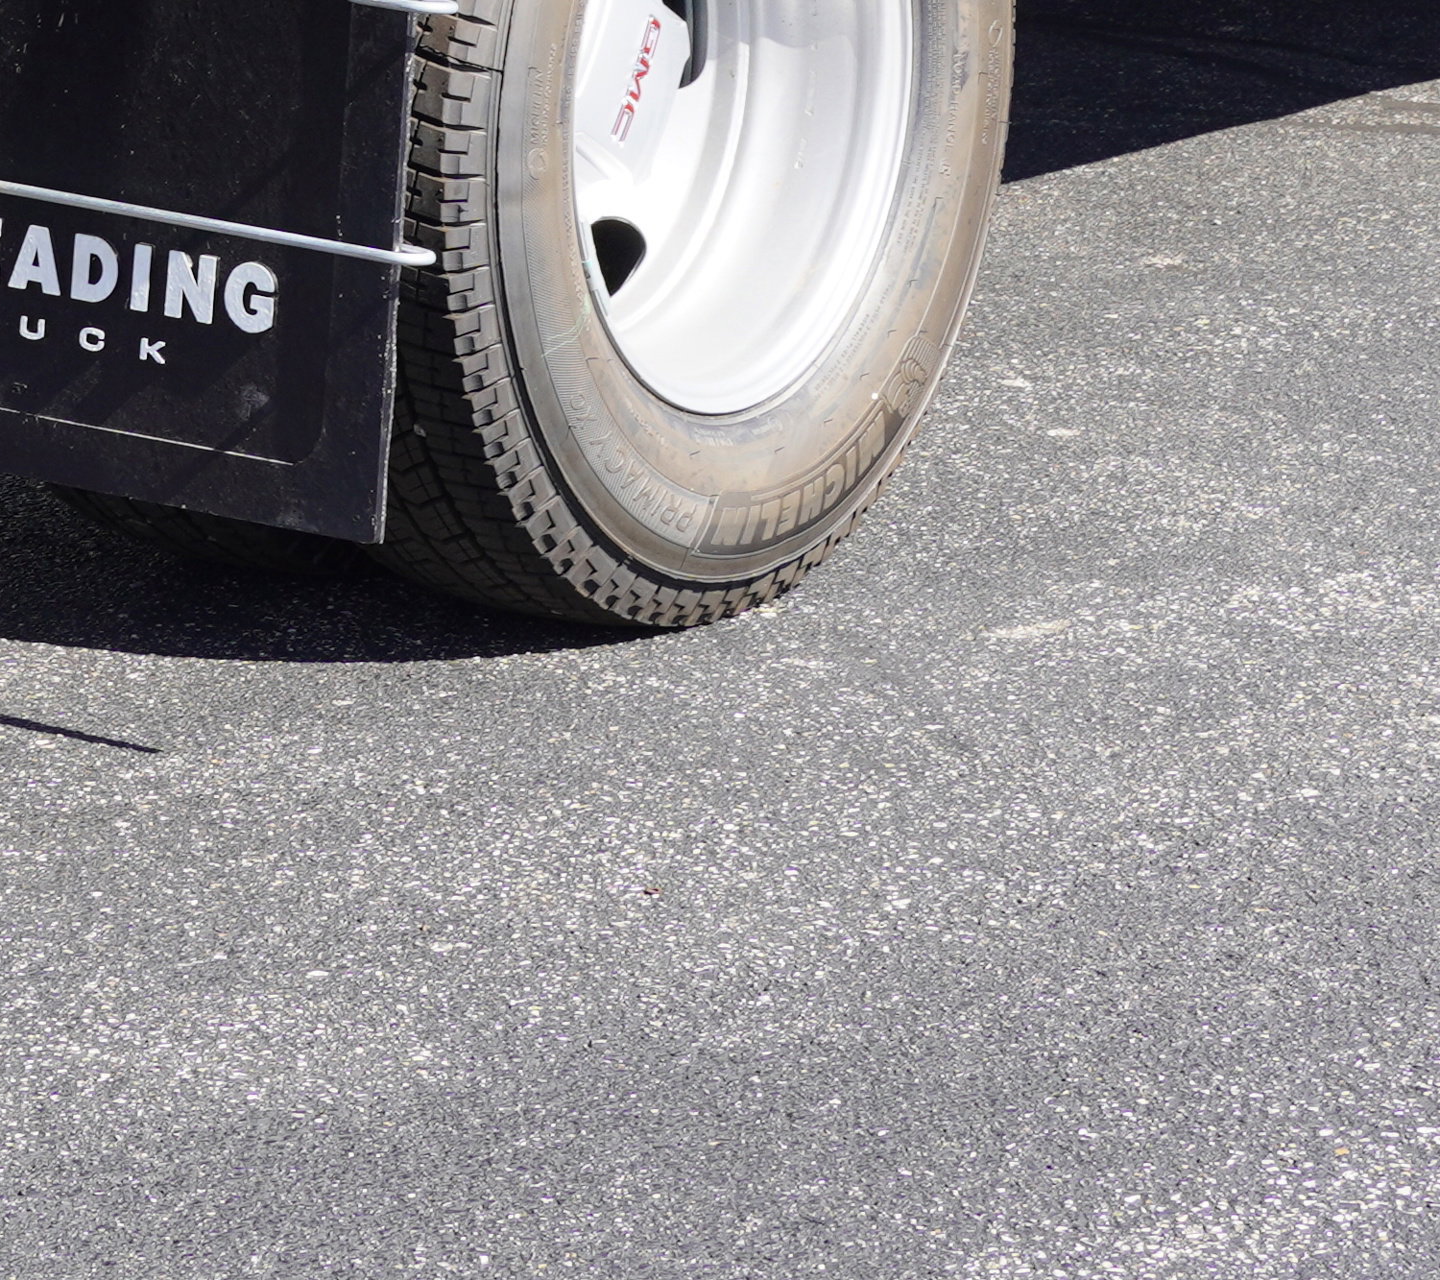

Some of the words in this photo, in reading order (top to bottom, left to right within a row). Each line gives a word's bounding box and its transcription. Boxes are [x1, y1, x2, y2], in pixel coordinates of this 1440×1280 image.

[610, 14, 662, 148] GMC
[591, 430, 697, 533] PRIMACY
[711, 405, 887, 547] MICHELIN
